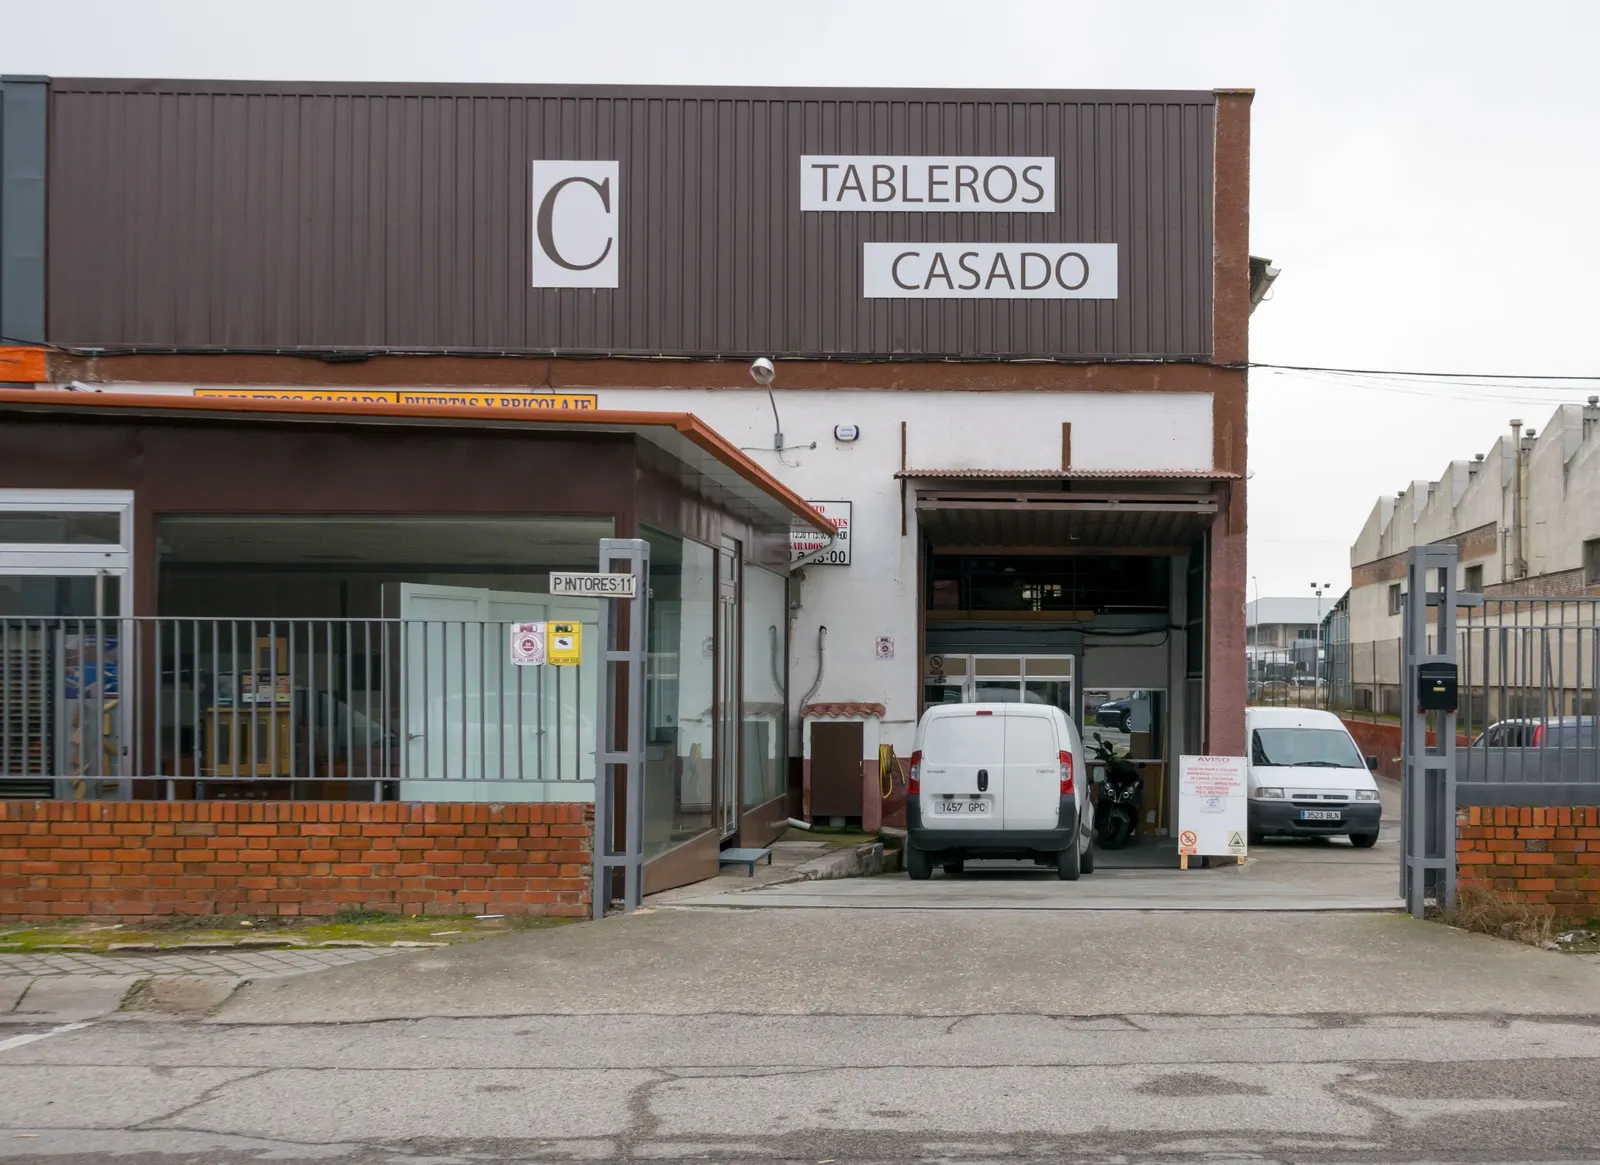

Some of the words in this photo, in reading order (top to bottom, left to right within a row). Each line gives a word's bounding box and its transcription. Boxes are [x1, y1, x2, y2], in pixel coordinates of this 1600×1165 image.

[811, 163, 1046, 205] TABLEROS
[536, 176, 613, 271] C
[891, 251, 1090, 292] CASADO
[942, 802, 963, 812] 1457
[968, 802, 986, 812] GPC
[1306, 811, 1324, 819] 3523
